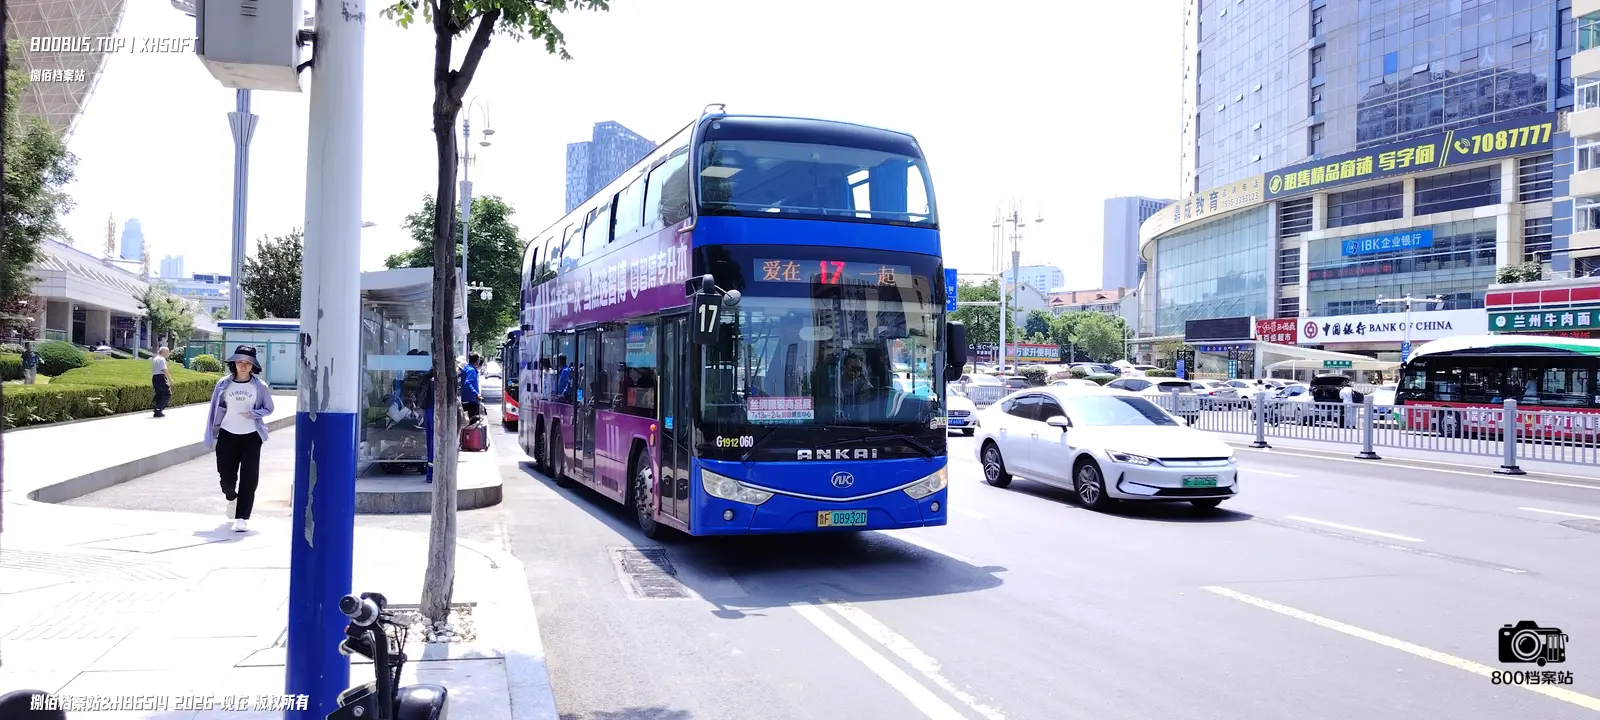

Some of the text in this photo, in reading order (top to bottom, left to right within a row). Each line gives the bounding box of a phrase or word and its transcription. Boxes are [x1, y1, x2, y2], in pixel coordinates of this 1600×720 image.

[1284, 122, 1552, 190] 租售精品商铺 写字间 7087777
[640, 243, 688, 291] 智博专升本
[762, 260, 896, 286] 爱在 17 一起
[699, 304, 718, 333] 17
[1322, 322, 1366, 336] 中国银行
[1369, 323, 1396, 332] BANK
[1416, 321, 1452, 330] CHINA
[1513, 311, 1590, 328] 兰州牛肉面
[797, 448, 878, 460] ANKAI
[833, 511, 866, 525] 08932D
